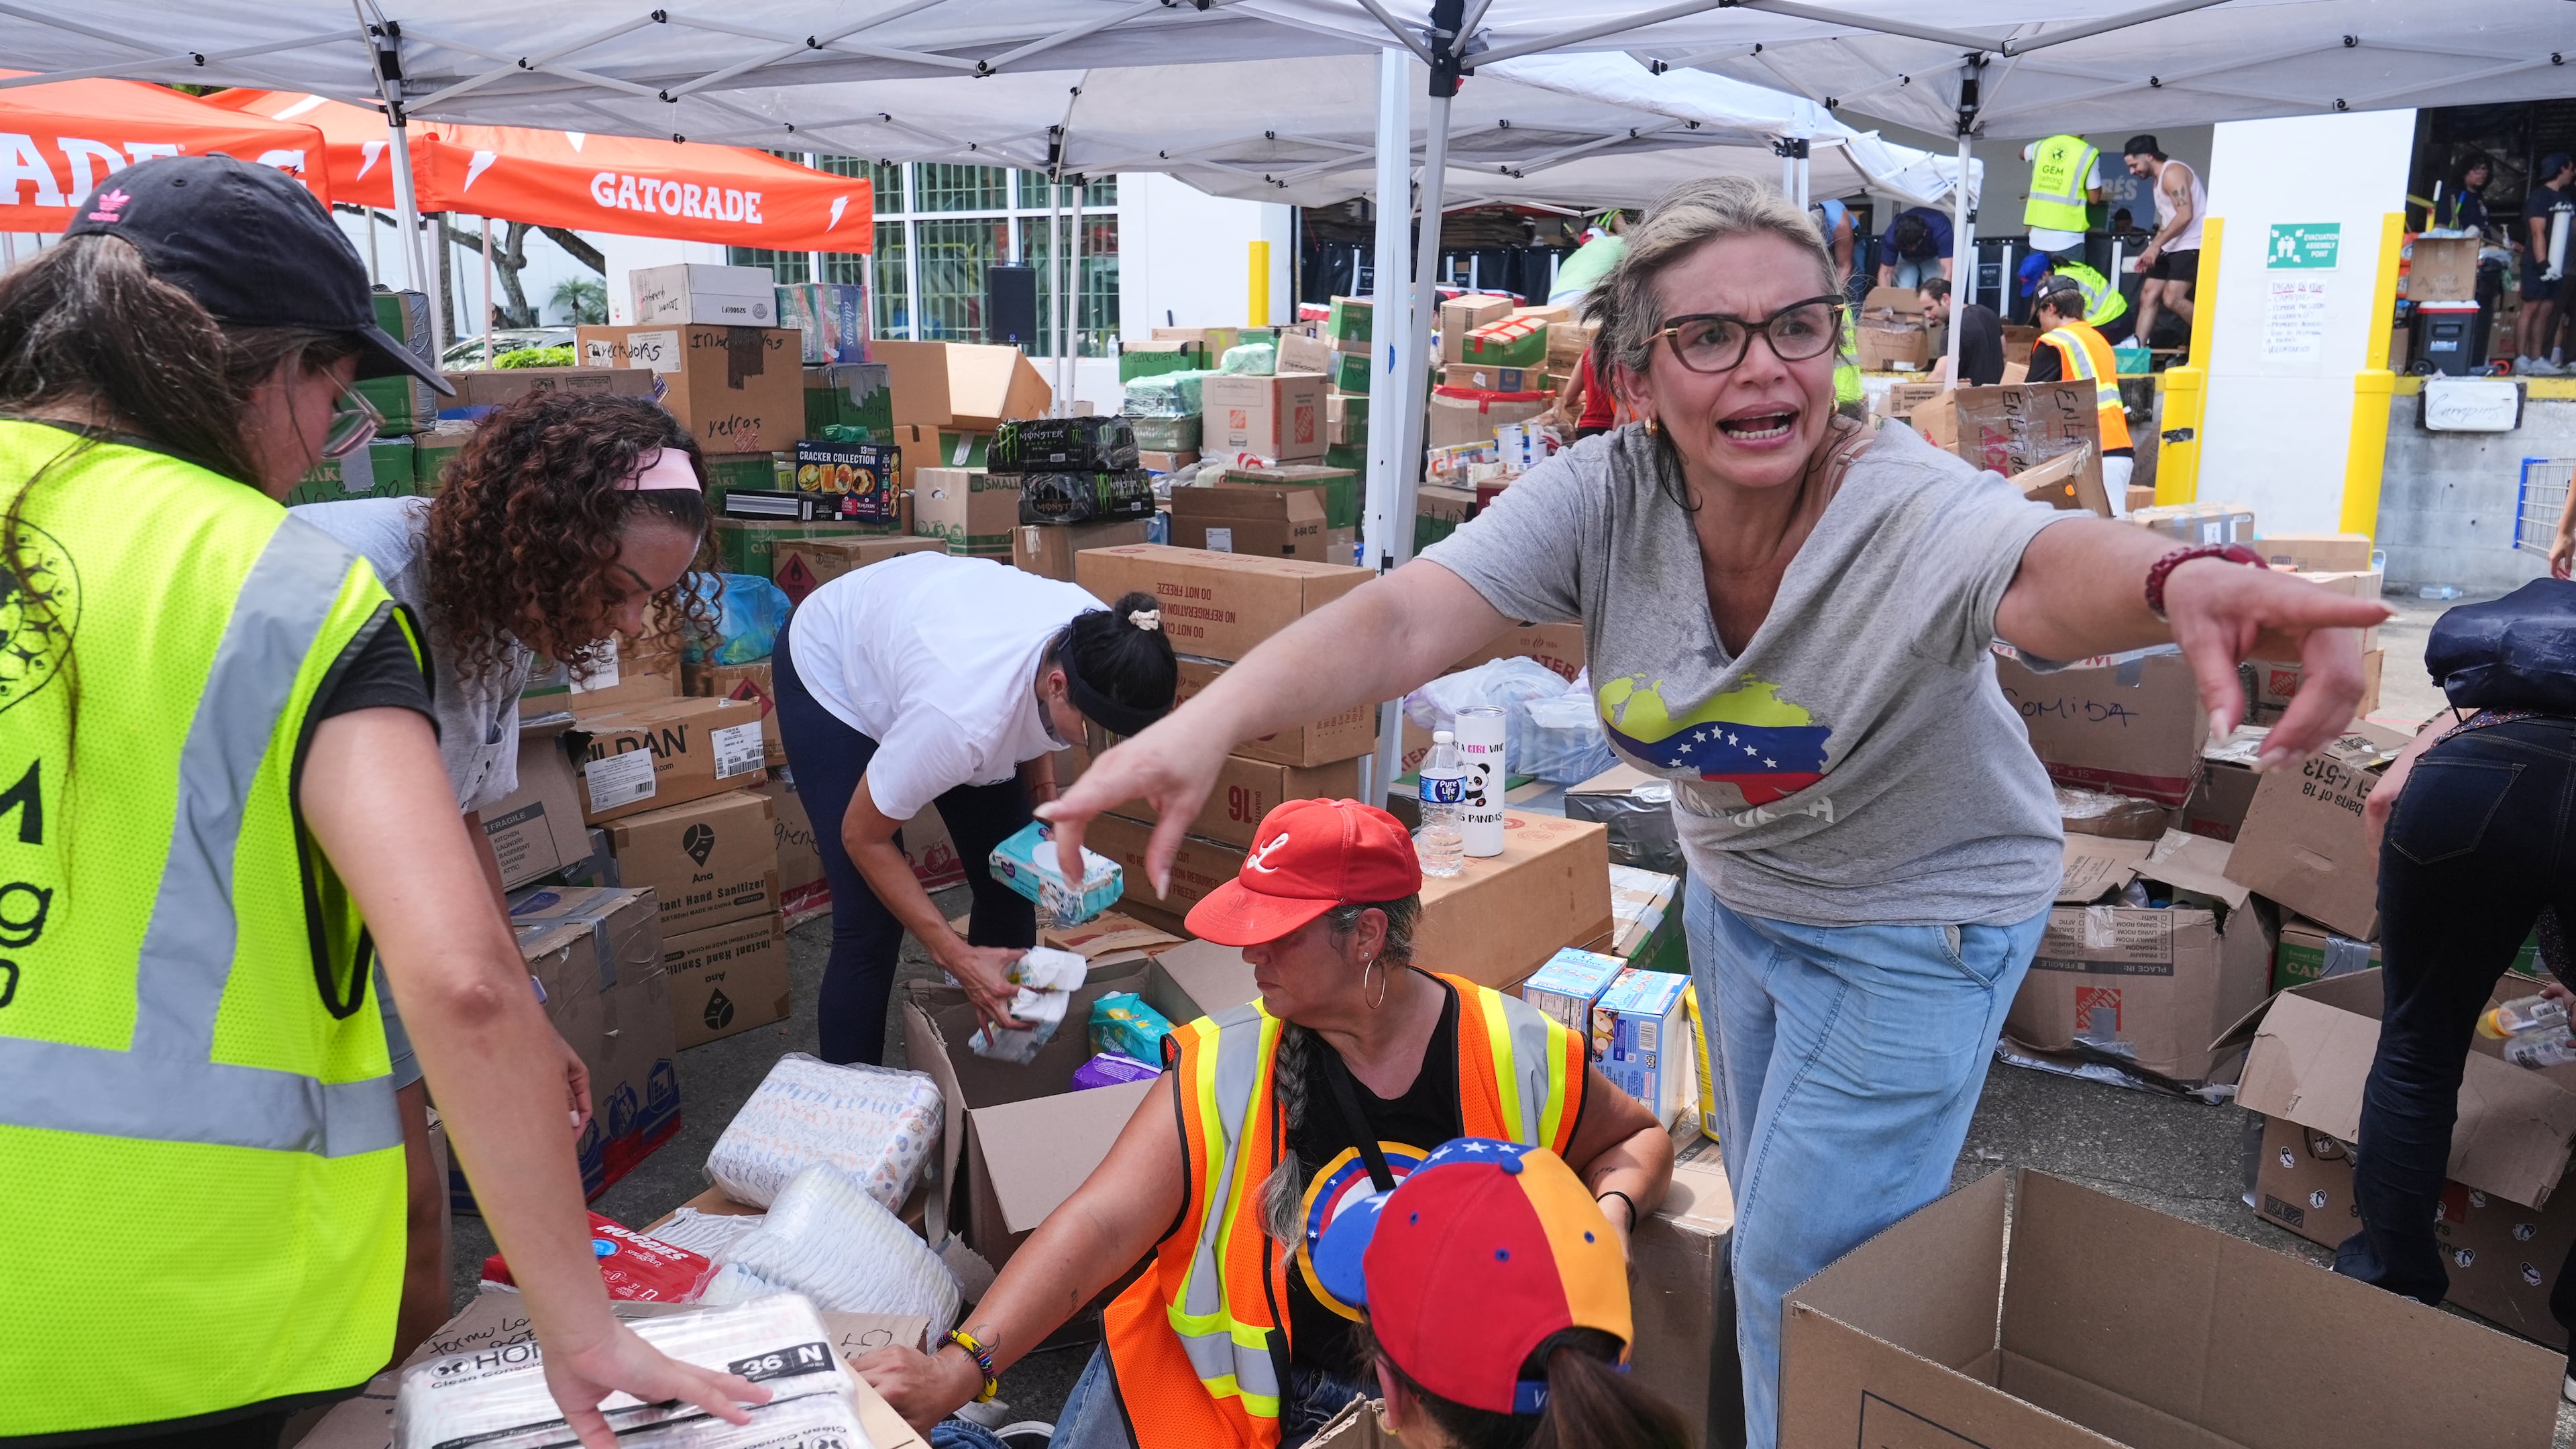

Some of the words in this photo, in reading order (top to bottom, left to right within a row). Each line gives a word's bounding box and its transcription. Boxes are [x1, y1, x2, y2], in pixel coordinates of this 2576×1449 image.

[2043, 166, 2063, 176] GEM
[590, 172, 762, 224] GATORADE
[2304, 233, 2339, 241] EVACUATION
[2306, 241, 2336, 250] ASSEMBLY
[721, 305, 747, 315] 52906(F)
[843, 301, 855, 347] always
[1019, 430, 1063, 440] MONSTER
[860, 446, 867, 455] 13
[799, 450, 832, 463] CRACKER
[833, 453, 875, 465] COLLECTION
[984, 477, 1020, 490] SMALL
[1309, 525, 1318, 534] OZ
[1157, 582, 1183, 598] FREEZE
[1184, 586, 1199, 600] NOT
[1201, 588, 1211, 600] DO
[1168, 606, 1223, 623] REFRIGERATION
[1224, 611, 1235, 624] NO
[1165, 625, 1175, 635] CU
[1177, 626, 1193, 637] NOT
[1193, 627, 1203, 639] DO
[1461, 743, 1465, 752] A
[1467, 745, 1487, 754] GIRL
[1440, 780, 1458, 790] Pure
[1442, 786, 1456, 796] Life
[2302, 782, 2316, 797] 18
[2318, 788, 2332, 801] of
[1228, 786, 1252, 824] 16
[2334, 794, 2365, 817] bags
[490, 812, 526, 831] FRAGILE
[1468, 812, 1502, 823] PANDAS
[494, 830, 521, 844] KITCHEN
[496, 837, 524, 851] LAUNDRY
[498, 843, 530, 859] BASEMENT
[500, 853, 526, 867] GARAGE
[503, 864, 520, 875] ATTIC
[692, 873, 713, 883] Ana
[659, 898, 682, 912] tant
[686, 890, 712, 906] Hand
[717, 879, 765, 898] Sanitizer
[1173, 884, 1197, 901] FREEZE
[690, 908, 706, 916] MADE
[714, 902, 732, 910] CHINA
[687, 946, 704, 955] CHINA
[737, 939, 770, 957] Instant
[706, 949, 731, 965] Hand
[1566, 955, 1604, 967] Gerber
[665, 957, 701, 975] Saniti
[2041, 960, 2075, 969] FRAGILE
[2123, 964, 2137, 972] IN:
[2138, 965, 2167, 973] PLACE
[705, 971, 726, 983] Ana
[1538, 981, 1565, 992] VARIETY
[1566, 987, 1585, 996] PACK
[2266, 1201, 2284, 1216] USA
[596, 1224, 689, 1260] HUGGIES
[742, 1354, 784, 1376] 36
[798, 1344, 823, 1364] N
[432, 1375, 478, 1389] Clean
